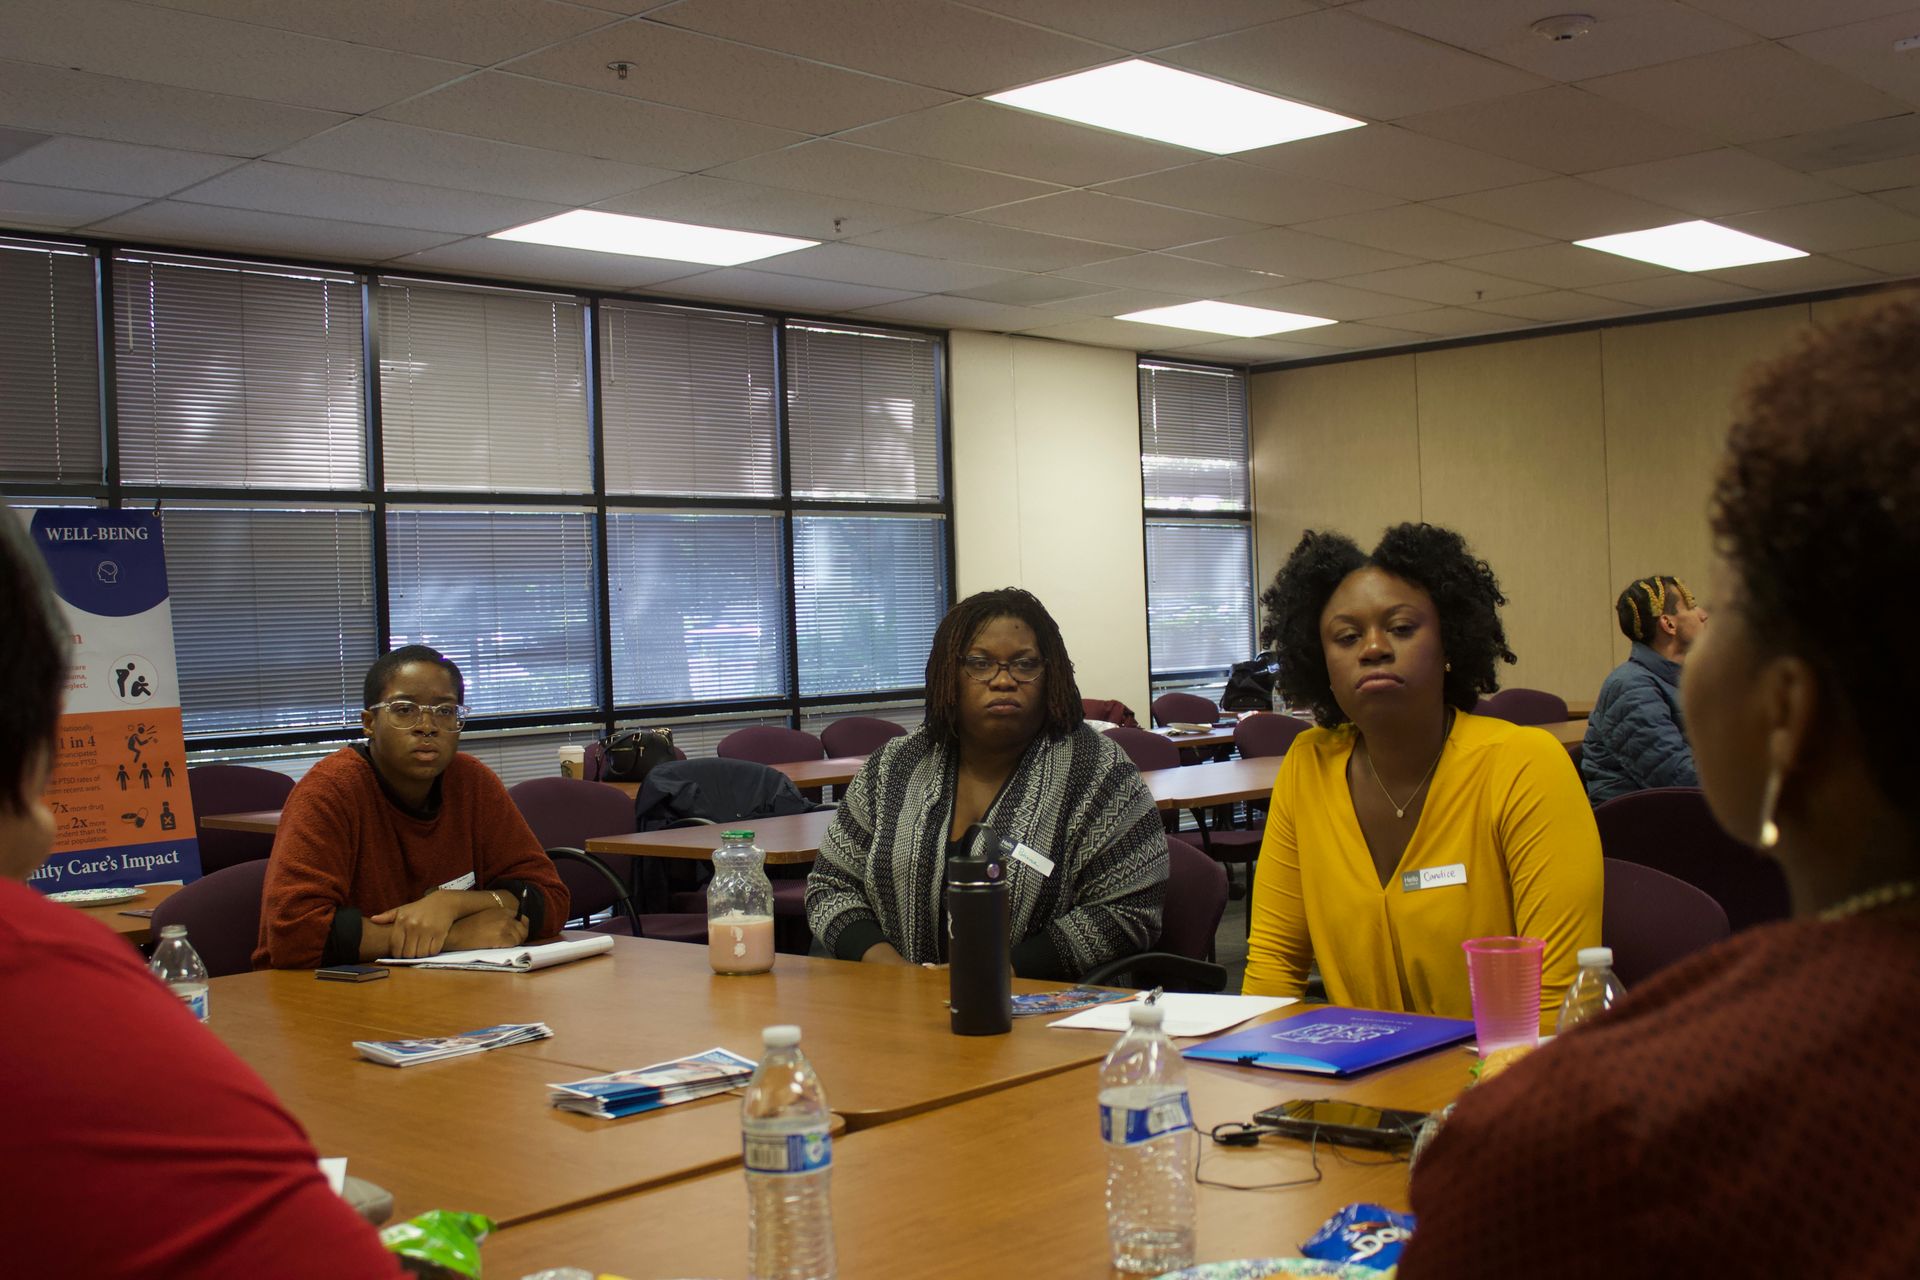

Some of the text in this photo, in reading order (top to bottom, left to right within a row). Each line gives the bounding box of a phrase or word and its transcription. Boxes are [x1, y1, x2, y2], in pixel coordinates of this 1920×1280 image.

[46, 527, 149, 541] WELL-BEING
[70, 736, 85, 749] in
[88, 735, 96, 747] 4
[51, 802, 69, 814] 7x
[71, 816, 89, 829] 2x
[67, 855, 118, 875] Care's
[121, 850, 180, 871] Impact
